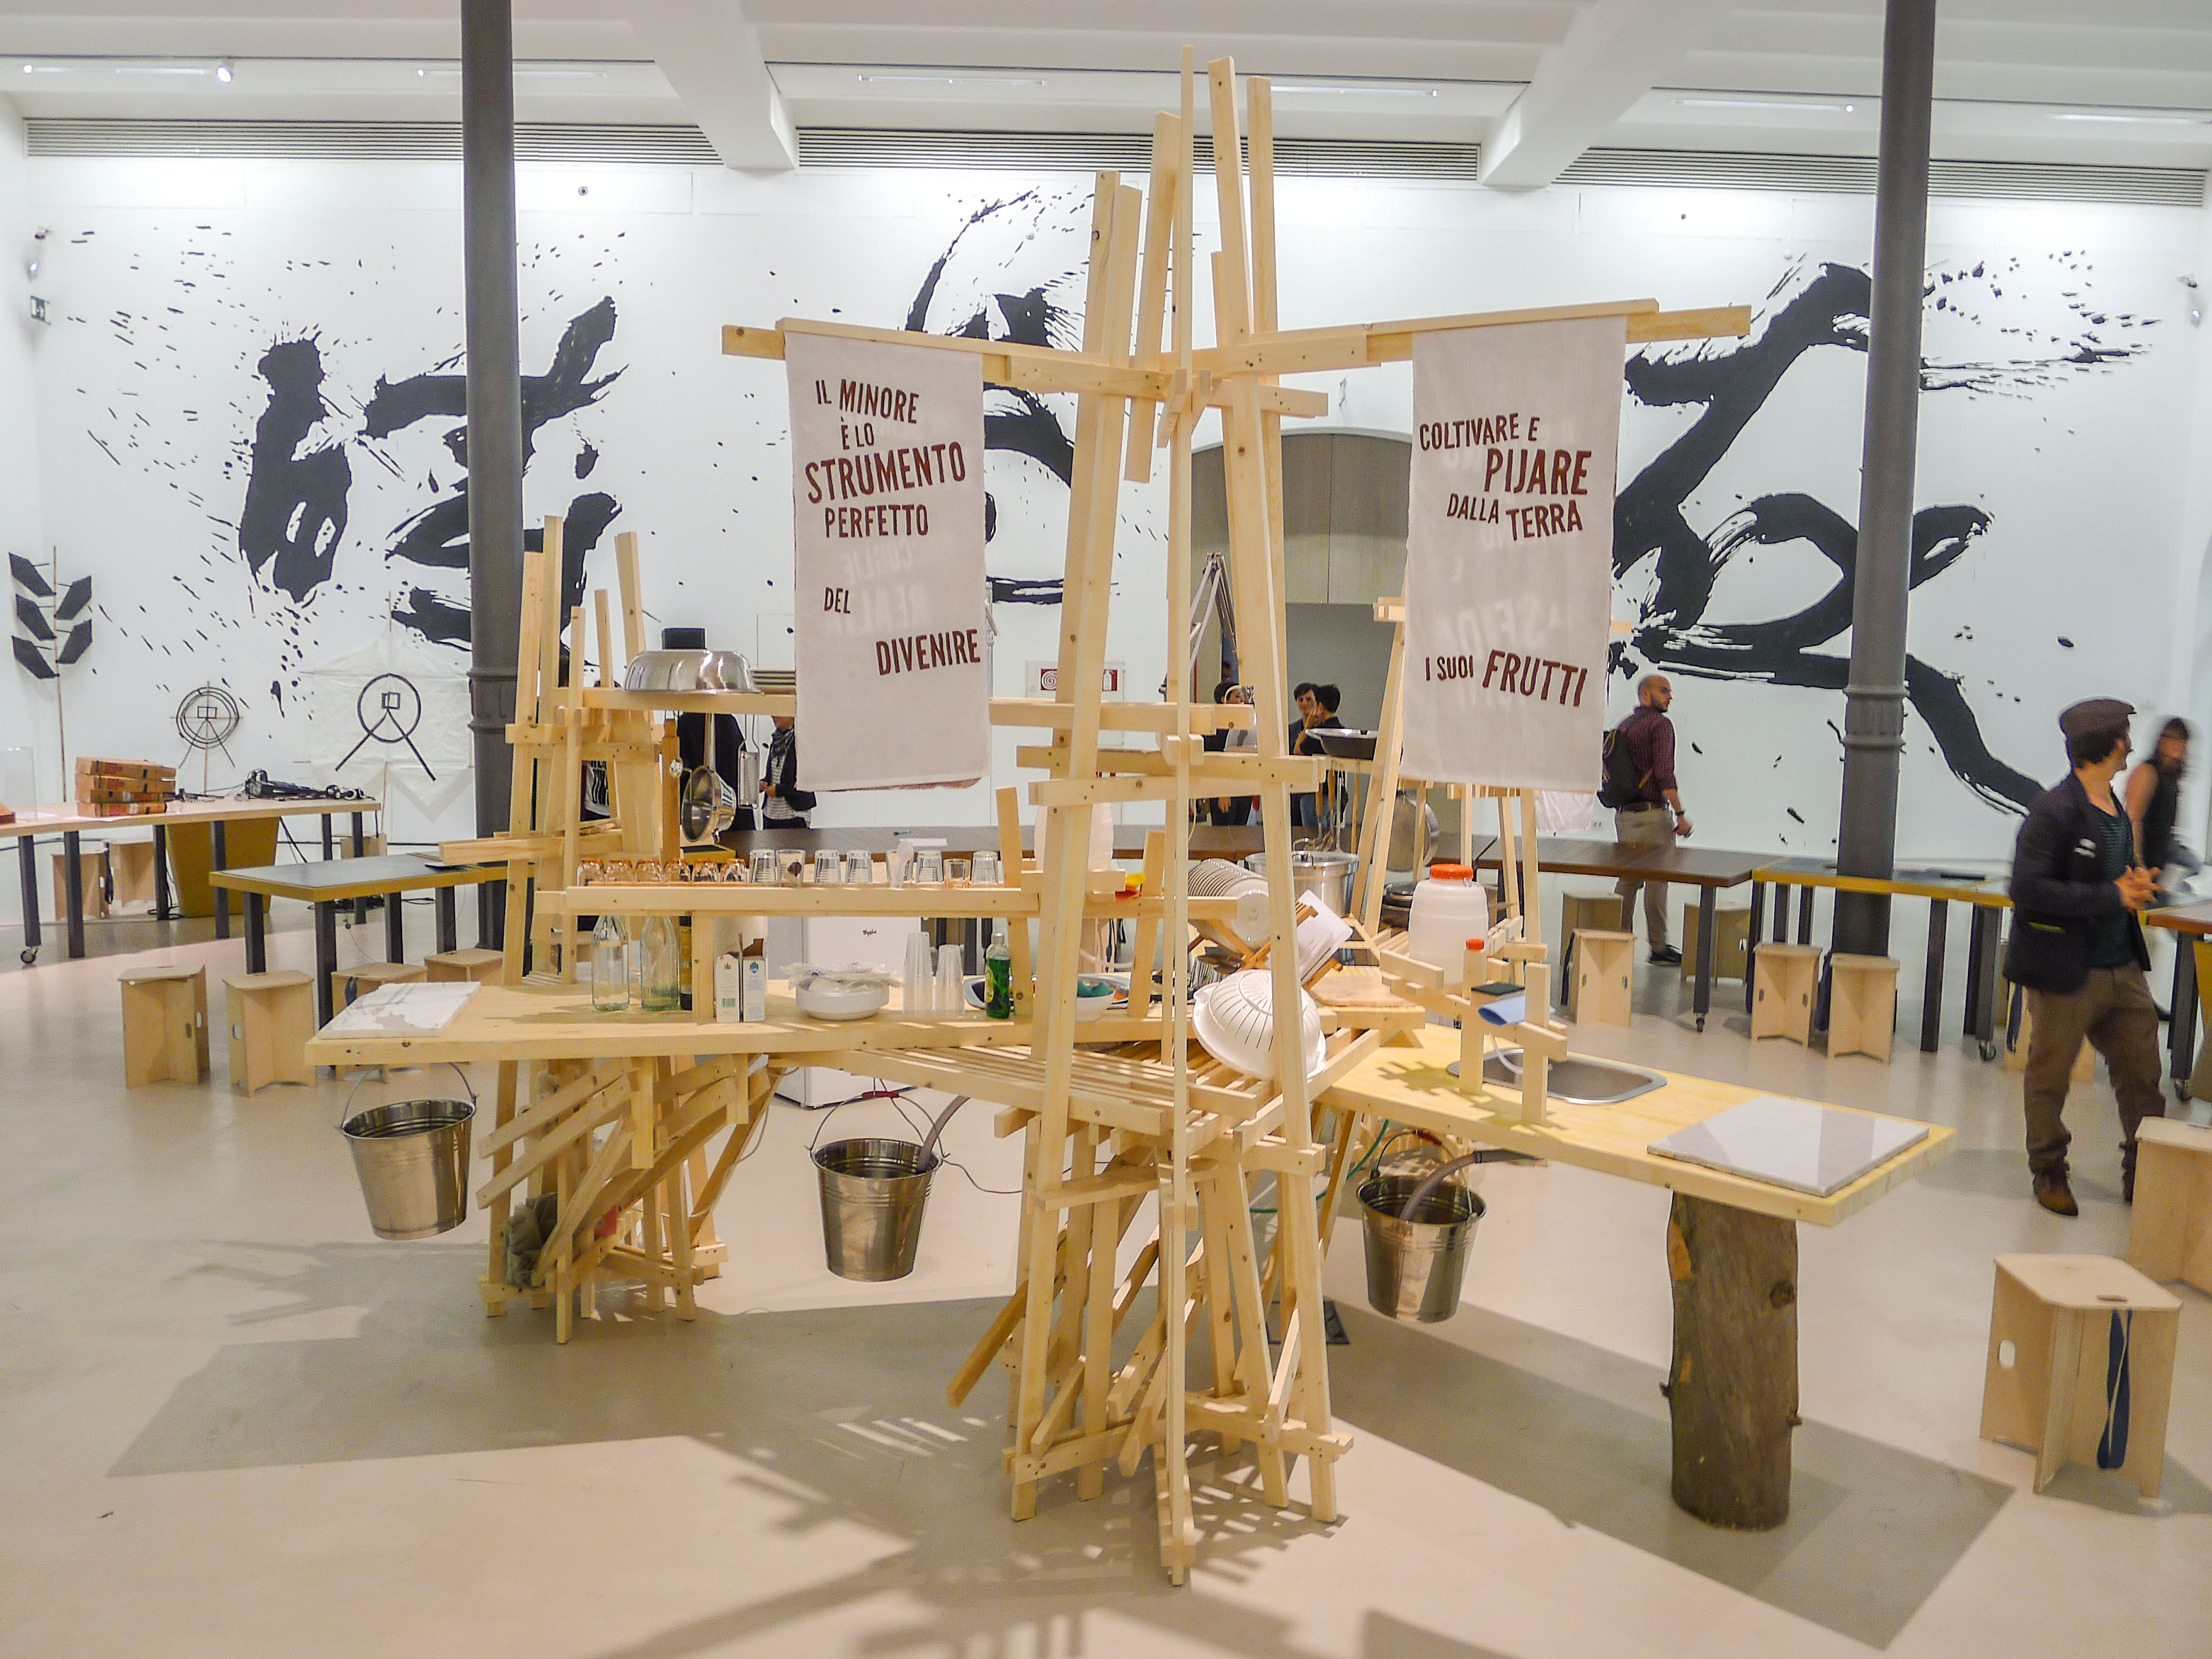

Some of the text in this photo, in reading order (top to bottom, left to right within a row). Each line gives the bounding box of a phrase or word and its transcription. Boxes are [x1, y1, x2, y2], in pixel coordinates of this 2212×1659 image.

[816, 379, 919, 424] IL MINORE
[840, 415, 874, 450] È LO
[1419, 413, 1540, 451] COLTIVARE E
[805, 441, 965, 504] STRUMENTO
[1484, 448, 1592, 495] PIJARE
[825, 504, 928, 538] PERFETTO
[1447, 493, 1583, 541] DALLA TERRA
[824, 587, 850, 614] DEL
[876, 629, 980, 675] DIVENIRE
[1426, 657, 1430, 681] I
[1437, 655, 1473, 681] SUOI
[1483, 649, 1587, 706] FRUTTI
